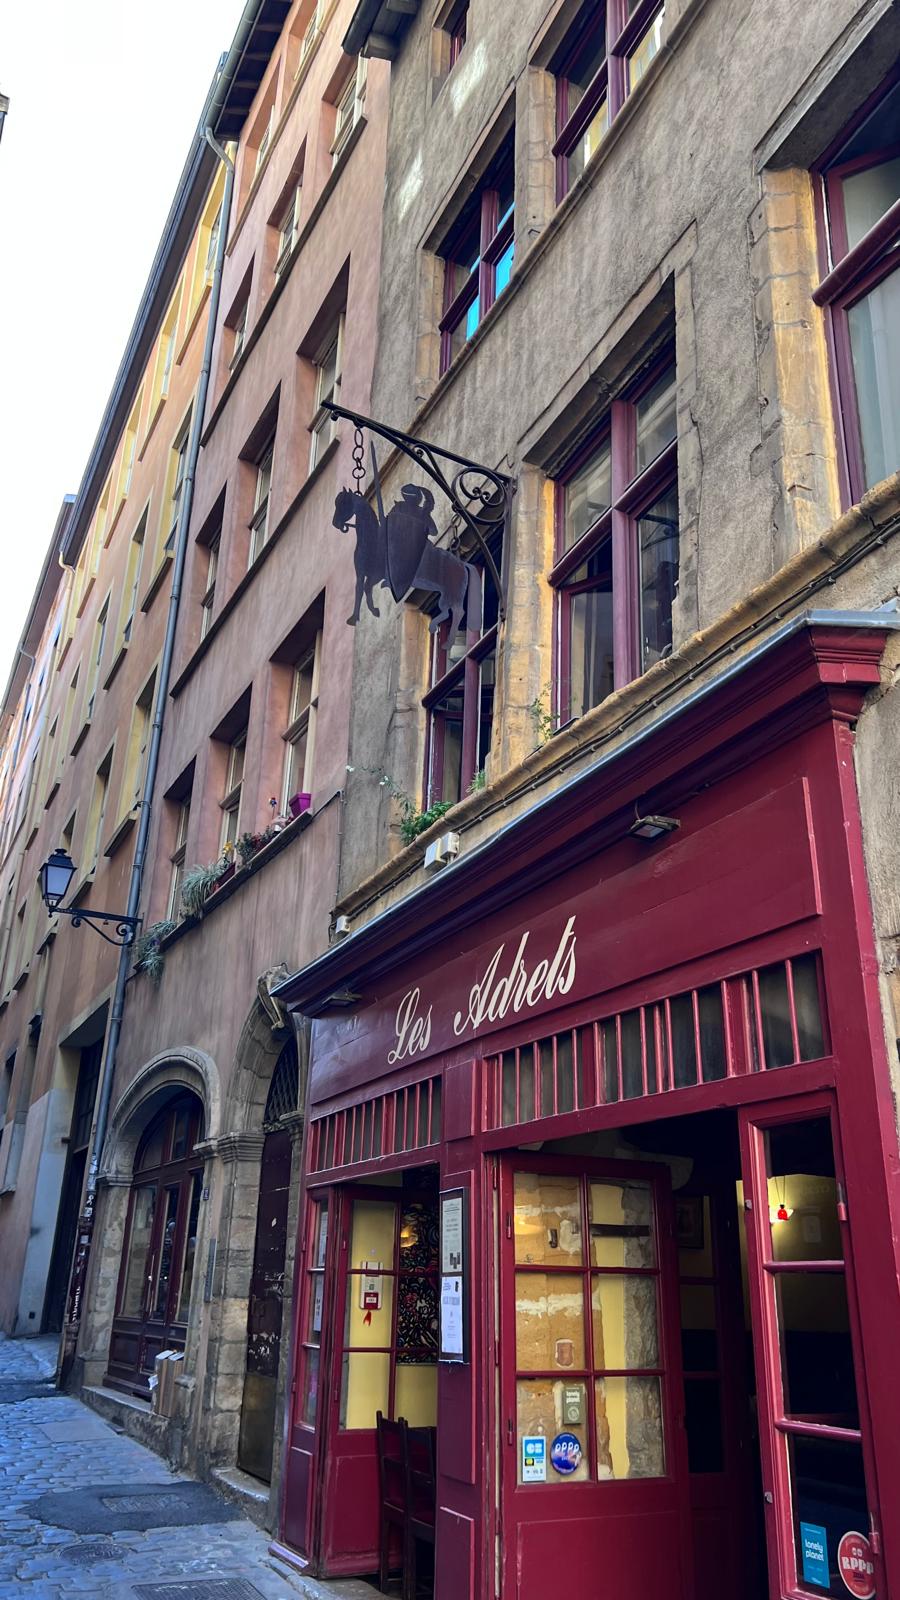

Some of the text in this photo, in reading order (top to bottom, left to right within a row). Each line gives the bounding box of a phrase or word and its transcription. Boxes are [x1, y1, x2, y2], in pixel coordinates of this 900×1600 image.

[388, 915, 577, 1064] Les Adrets
[804, 1539, 823, 1553] lonely
[805, 1549, 824, 1562] planet
